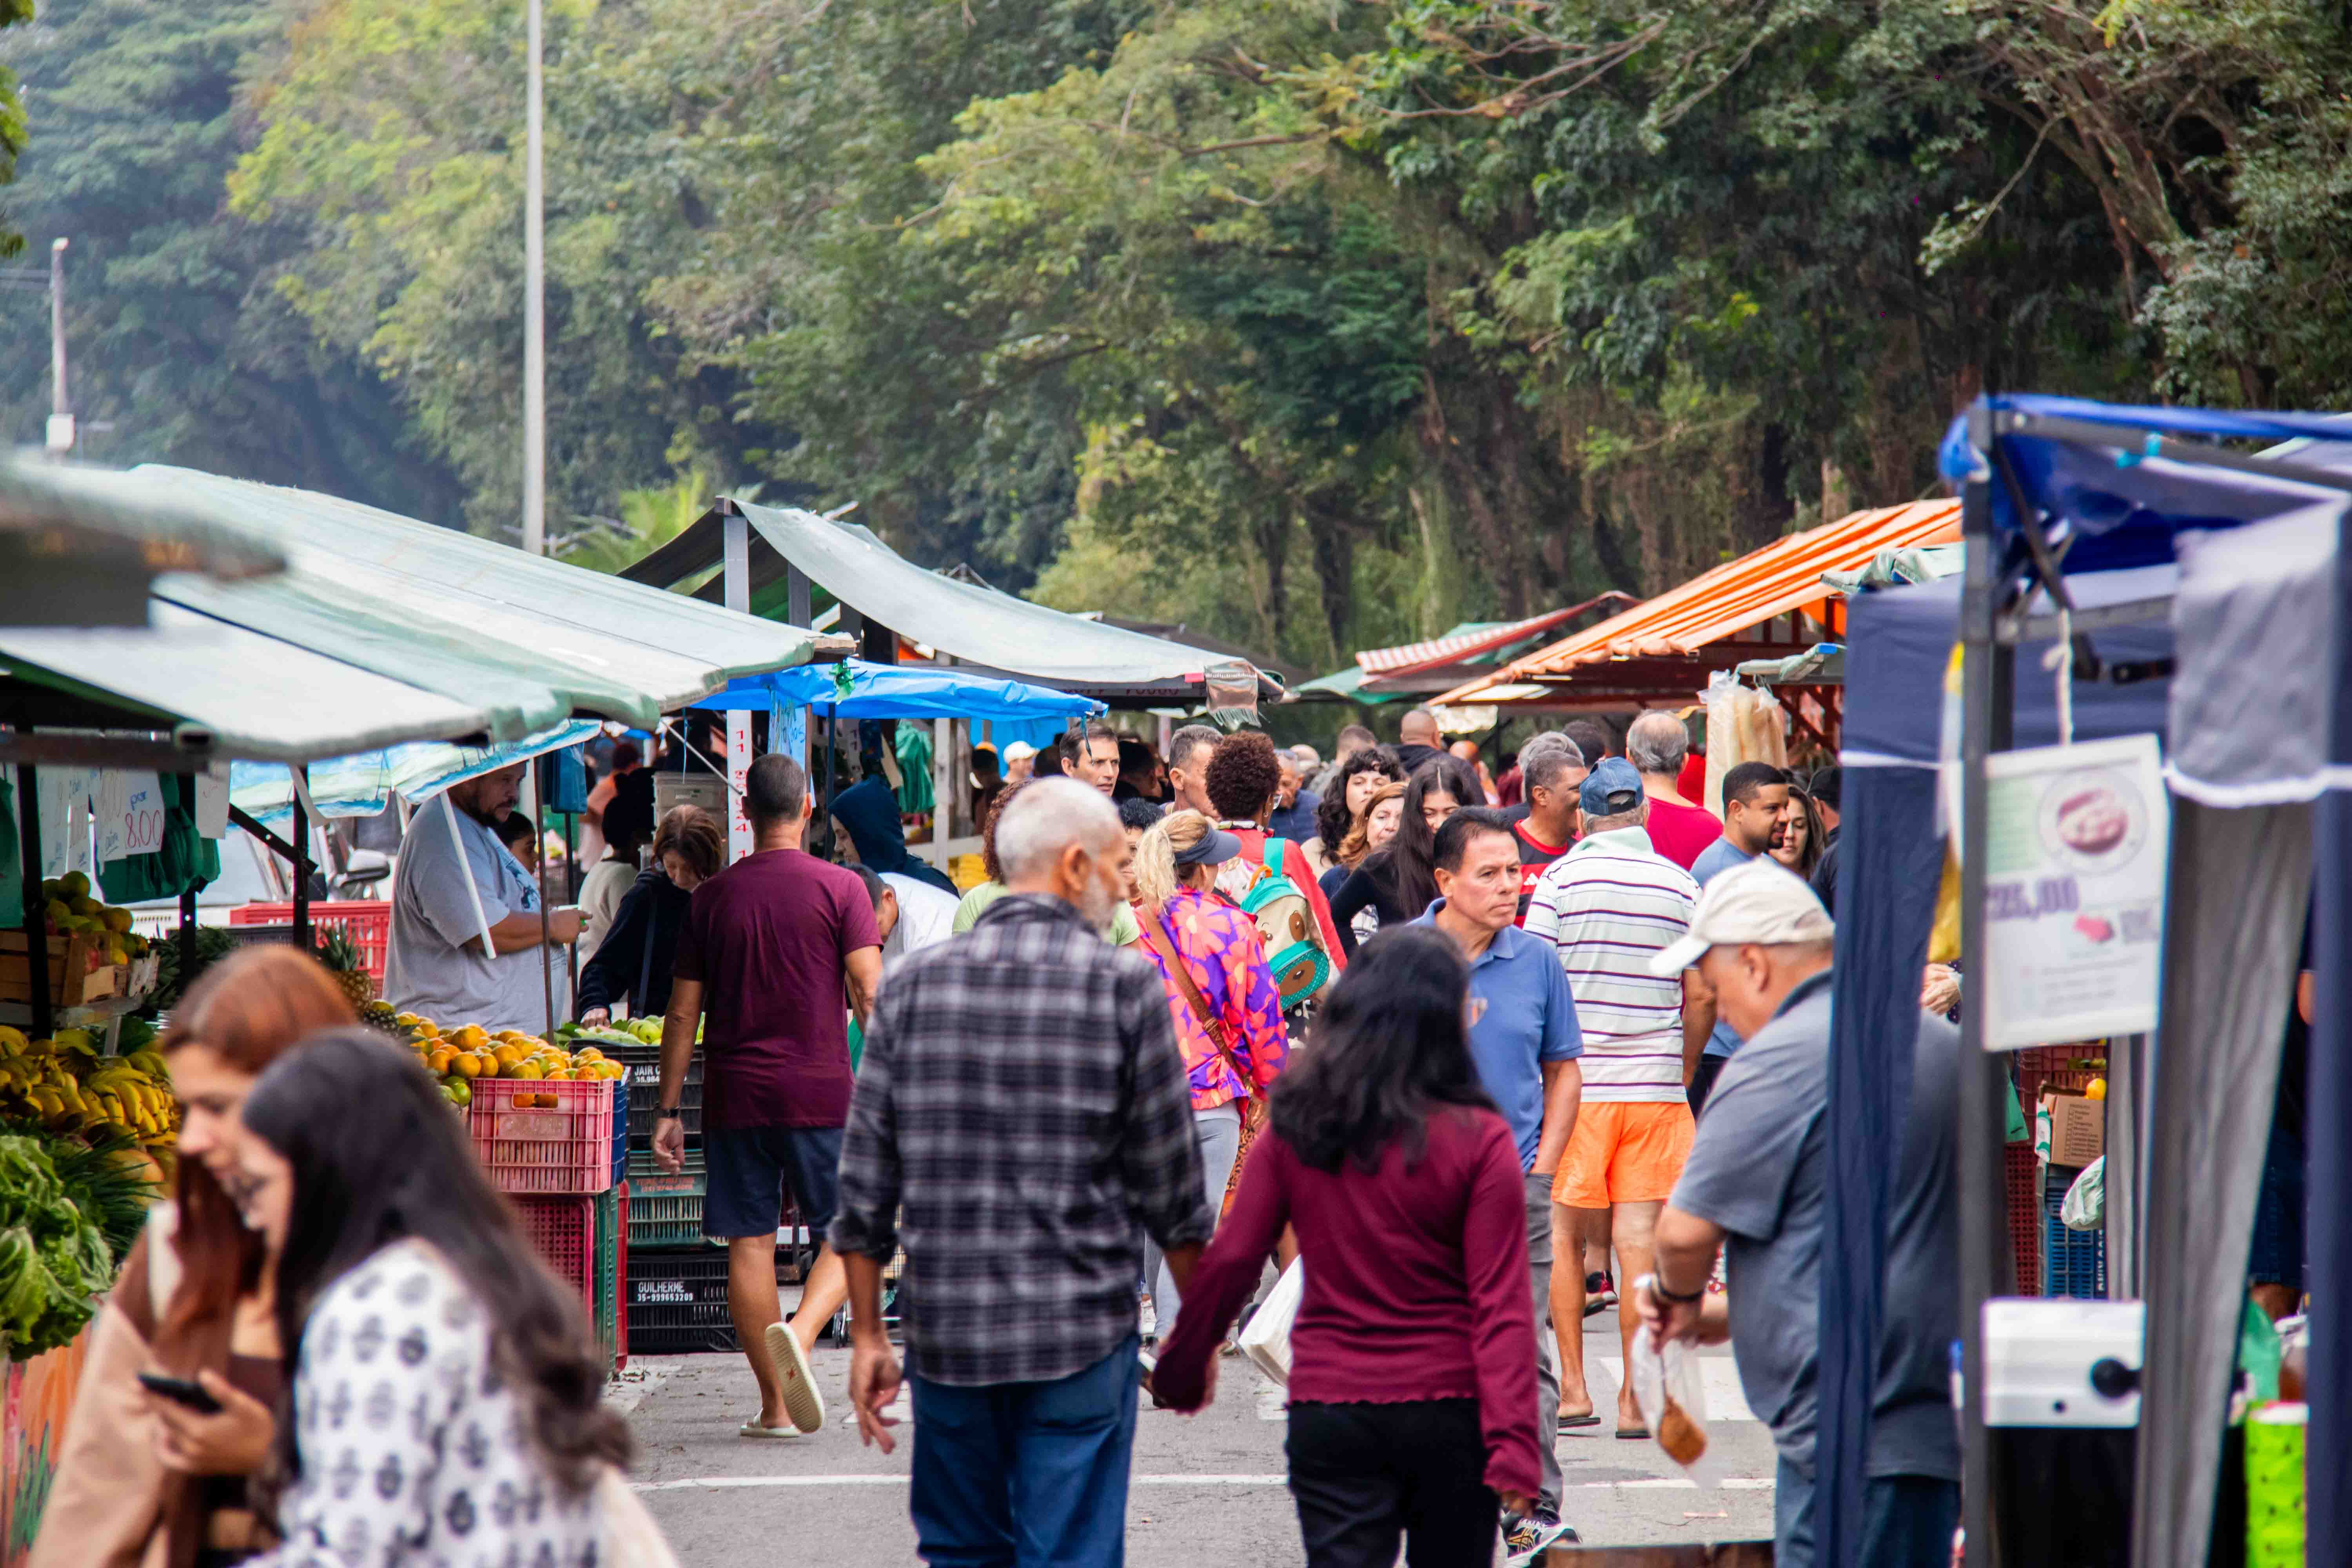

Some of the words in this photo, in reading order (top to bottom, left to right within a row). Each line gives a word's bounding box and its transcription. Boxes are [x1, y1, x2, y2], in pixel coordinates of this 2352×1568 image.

[125, 809, 163, 848] 8,00
[634, 1065, 653, 1076] JAIR
[638, 1281, 685, 1293] GUILHERME
